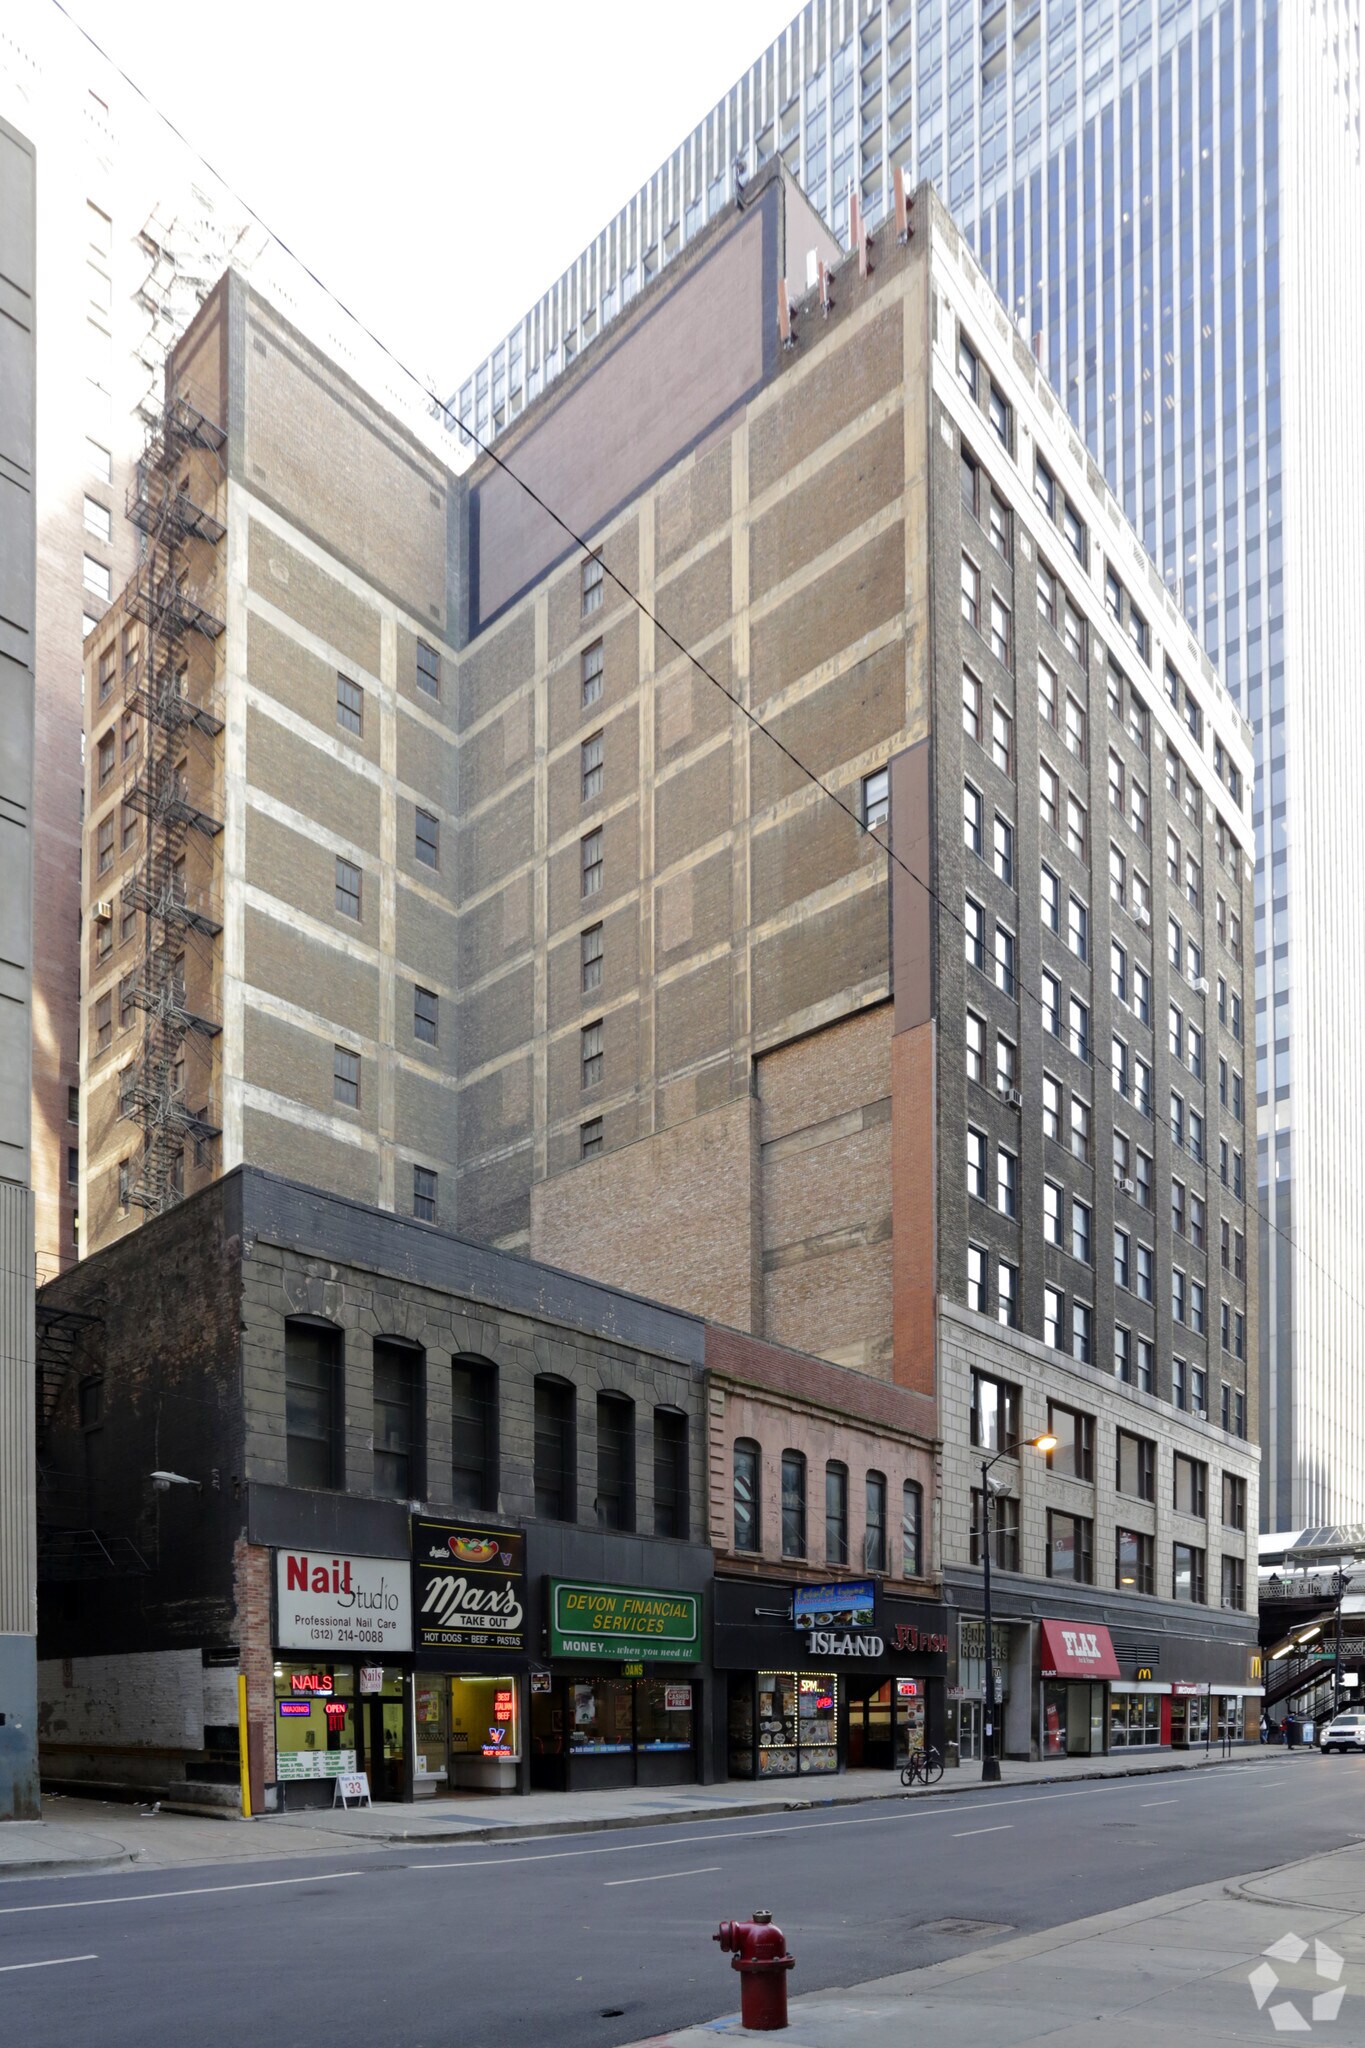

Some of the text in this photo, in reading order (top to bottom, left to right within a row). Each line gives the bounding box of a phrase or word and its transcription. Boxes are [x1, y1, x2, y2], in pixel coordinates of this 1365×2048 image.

[287, 1555, 351, 1594] Nail
[337, 1577, 399, 1611] Studio
[420, 1575, 519, 1622] Max's
[566, 1594, 688, 1618] DEVON FINANCIAL
[294, 1615, 397, 1630] Professional Nail Care
[460, 1615, 508, 1628] TAKE OUT
[592, 1614, 665, 1633] SERVICES
[310, 1629, 384, 1643] (312) 214-0088
[424, 1632, 439, 1642] HOT
[441, 1633, 462, 1643] DOGS
[471, 1634, 489, 1644] BEEF
[497, 1636, 520, 1646] PASTAS
[919, 1632, 948, 1653] FISH
[809, 1631, 884, 1657] ISLAND
[1062, 1631, 1101, 1657] FLAX
[617, 1646, 640, 1655] when
[642, 1648, 658, 1657] you
[660, 1647, 680, 1657] need
[682, 1649, 692, 1657] it!
[291, 1675, 333, 1690] NAILS
[361, 1669, 381, 1682] Nails
[497, 1692, 511, 1701] BEST
[816, 1697, 832, 1709] OPEN
[282, 1705, 309, 1713] WAXING
[325, 1703, 346, 1713] OPEN
[497, 1711, 511, 1720] BEEF
